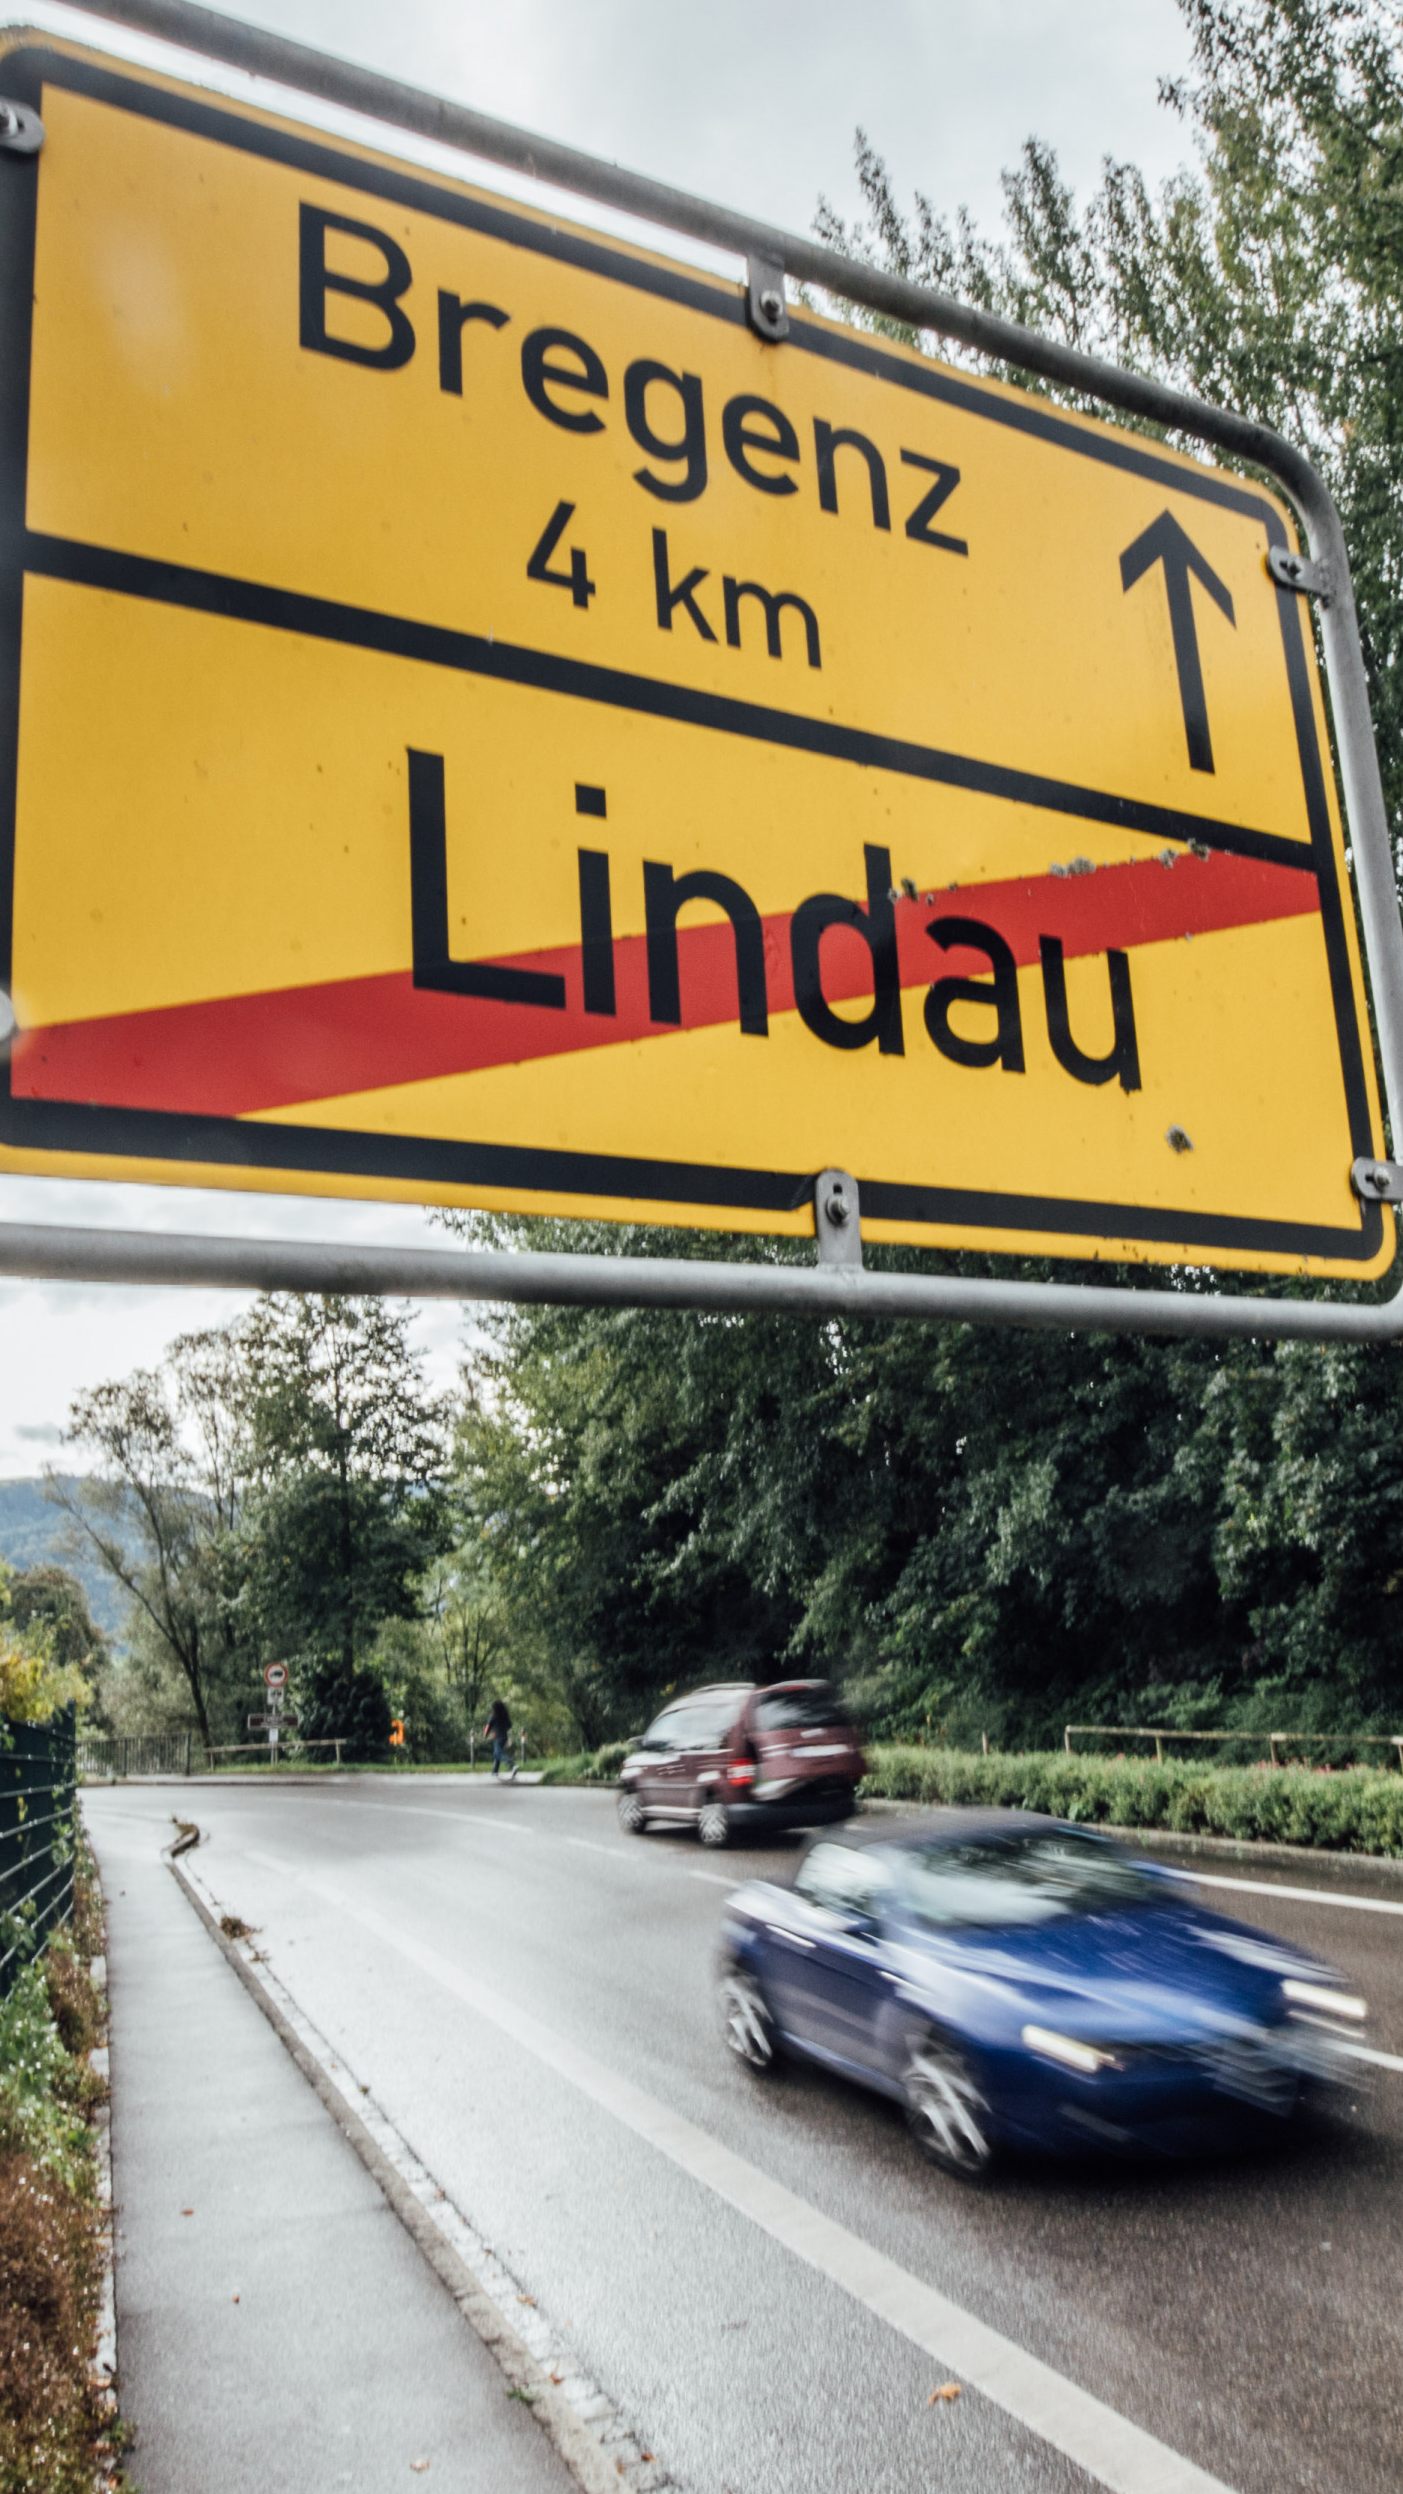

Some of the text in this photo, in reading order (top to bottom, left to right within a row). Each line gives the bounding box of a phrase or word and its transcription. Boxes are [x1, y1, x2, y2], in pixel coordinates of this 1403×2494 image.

[299, 201, 969, 556] Bregenz
[527, 500, 822, 671] 4 km
[407, 747, 1142, 1093] Lindau
